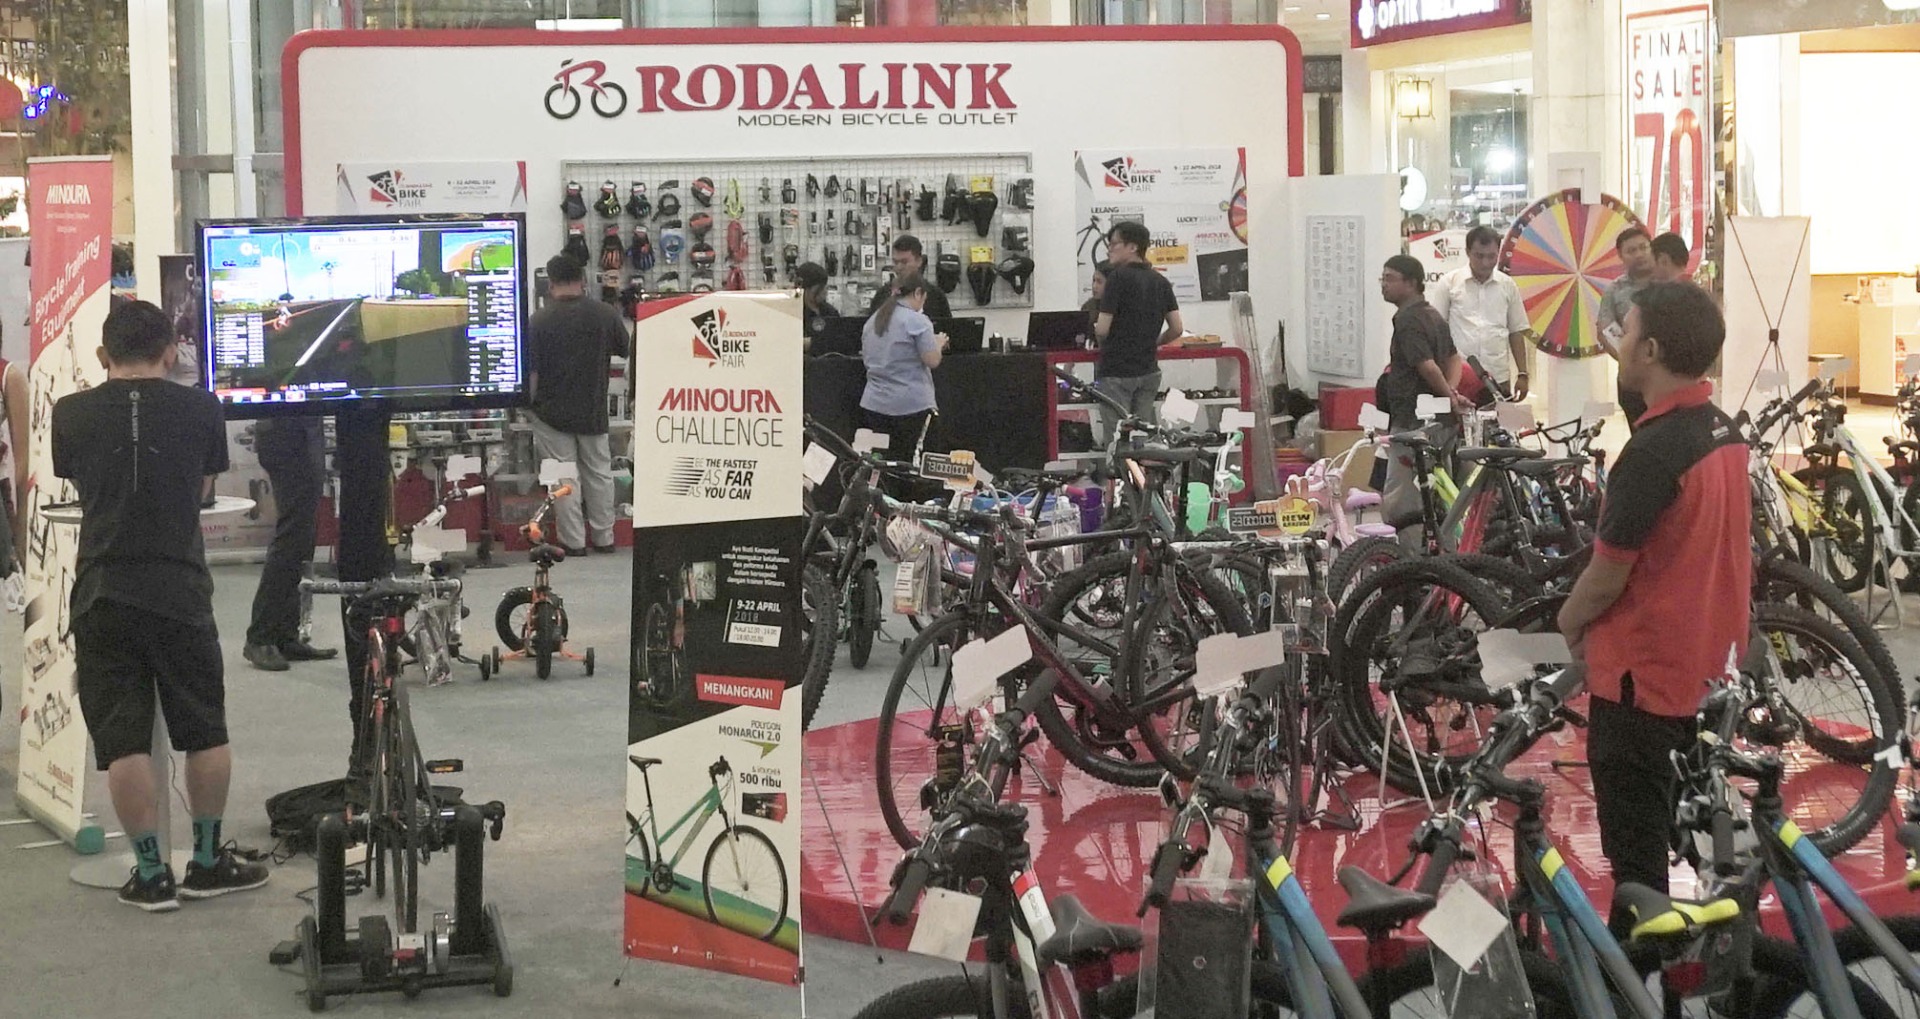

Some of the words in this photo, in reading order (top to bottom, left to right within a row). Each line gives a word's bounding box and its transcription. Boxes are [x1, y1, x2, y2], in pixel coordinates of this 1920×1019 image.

[1633, 29, 1702, 59] FINAL
[636, 62, 1018, 113] RODALINK
[1634, 65, 1702, 99] SALE
[737, 114, 831, 127] MODERN
[842, 113, 928, 126] BICYCLE
[938, 112, 1018, 126] OUTLET
[1131, 175, 1155, 184] BIKE
[46, 184, 92, 205] MINOURA
[399, 189, 426, 199] BIKE
[1131, 184, 1152, 192] FAIR
[1091, 206, 1120, 214] LELANG
[1150, 238, 1178, 248] PRICE
[65, 234, 101, 286] Training
[722, 339, 750, 353] BIKE
[722, 354, 745, 369] FAIR
[658, 388, 783, 413] MINOURA
[656, 415, 783, 447] CHALLENGE
[706, 458, 721, 468] THE
[723, 459, 758, 470] FASTEST
[702, 469, 722, 486] AS
[725, 470, 754, 487] FAR
[687, 486, 701, 498] AS
[704, 487, 726, 499] YOU
[728, 487, 751, 500] CAN
[1282, 514, 1310, 522] NEW
[736, 599, 756, 611] 9-22
[756, 600, 781, 613] APRIL
[734, 611, 759, 623] 2018
[703, 682, 773, 700] MENANGKAN!
[751, 720, 782, 731] POLYGON
[718, 725, 764, 741] MONARCH
[766, 731, 781, 742] 2.0
[740, 773, 759, 785] 500
[761, 775, 782, 789] ribu
